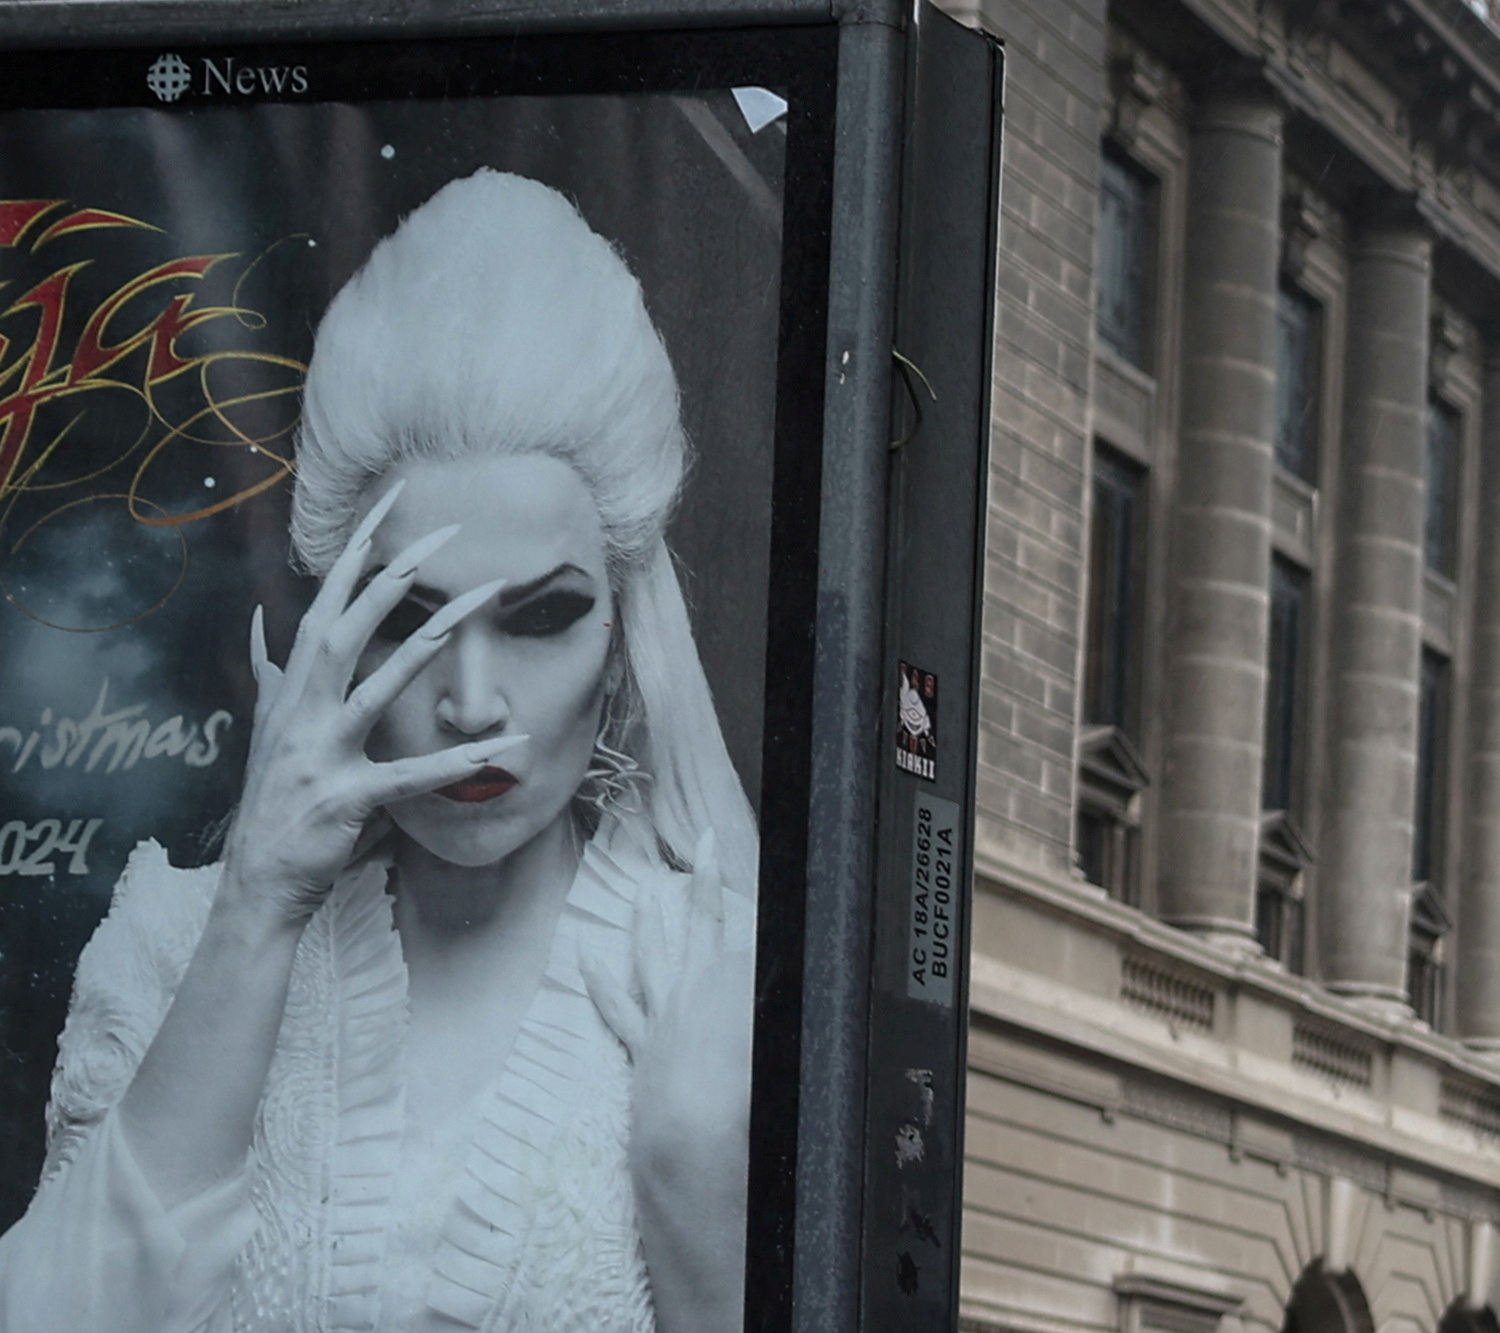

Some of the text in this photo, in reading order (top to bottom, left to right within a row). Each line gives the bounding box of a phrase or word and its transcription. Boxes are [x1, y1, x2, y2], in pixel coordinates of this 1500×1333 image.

[201, 57, 308, 95] News
[0, 818, 103, 876] 024
[913, 807, 932, 986] AC 18A/26628
[932, 828, 952, 978] BUCF0021A
